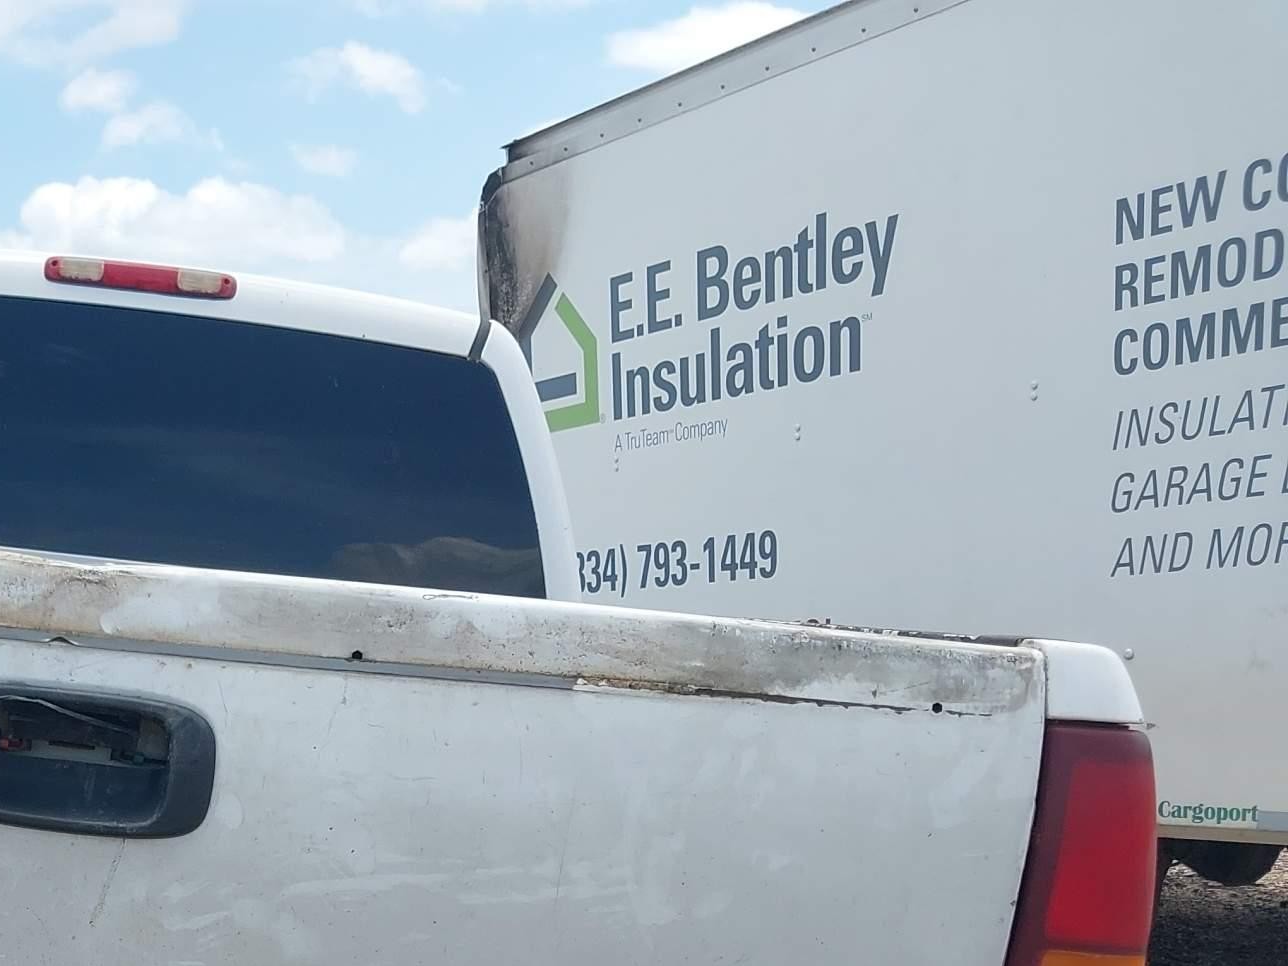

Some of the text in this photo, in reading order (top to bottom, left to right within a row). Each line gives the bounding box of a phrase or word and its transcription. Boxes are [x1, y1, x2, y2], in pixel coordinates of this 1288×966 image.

[1115, 169, 1228, 246] NEW
[609, 211, 899, 344] E.E. Bentley
[1114, 228, 1285, 311] REMOD
[611, 315, 861, 421] Insulation
[1113, 296, 1288, 376] COMME
[614, 418, 729, 453] A TruTeam Company
[1111, 453, 1273, 514] GARAGE
[636, 529, 778, 589] 793-1449
[1110, 531, 1194, 578] AND
[1158, 800, 1260, 825] Cargoport
